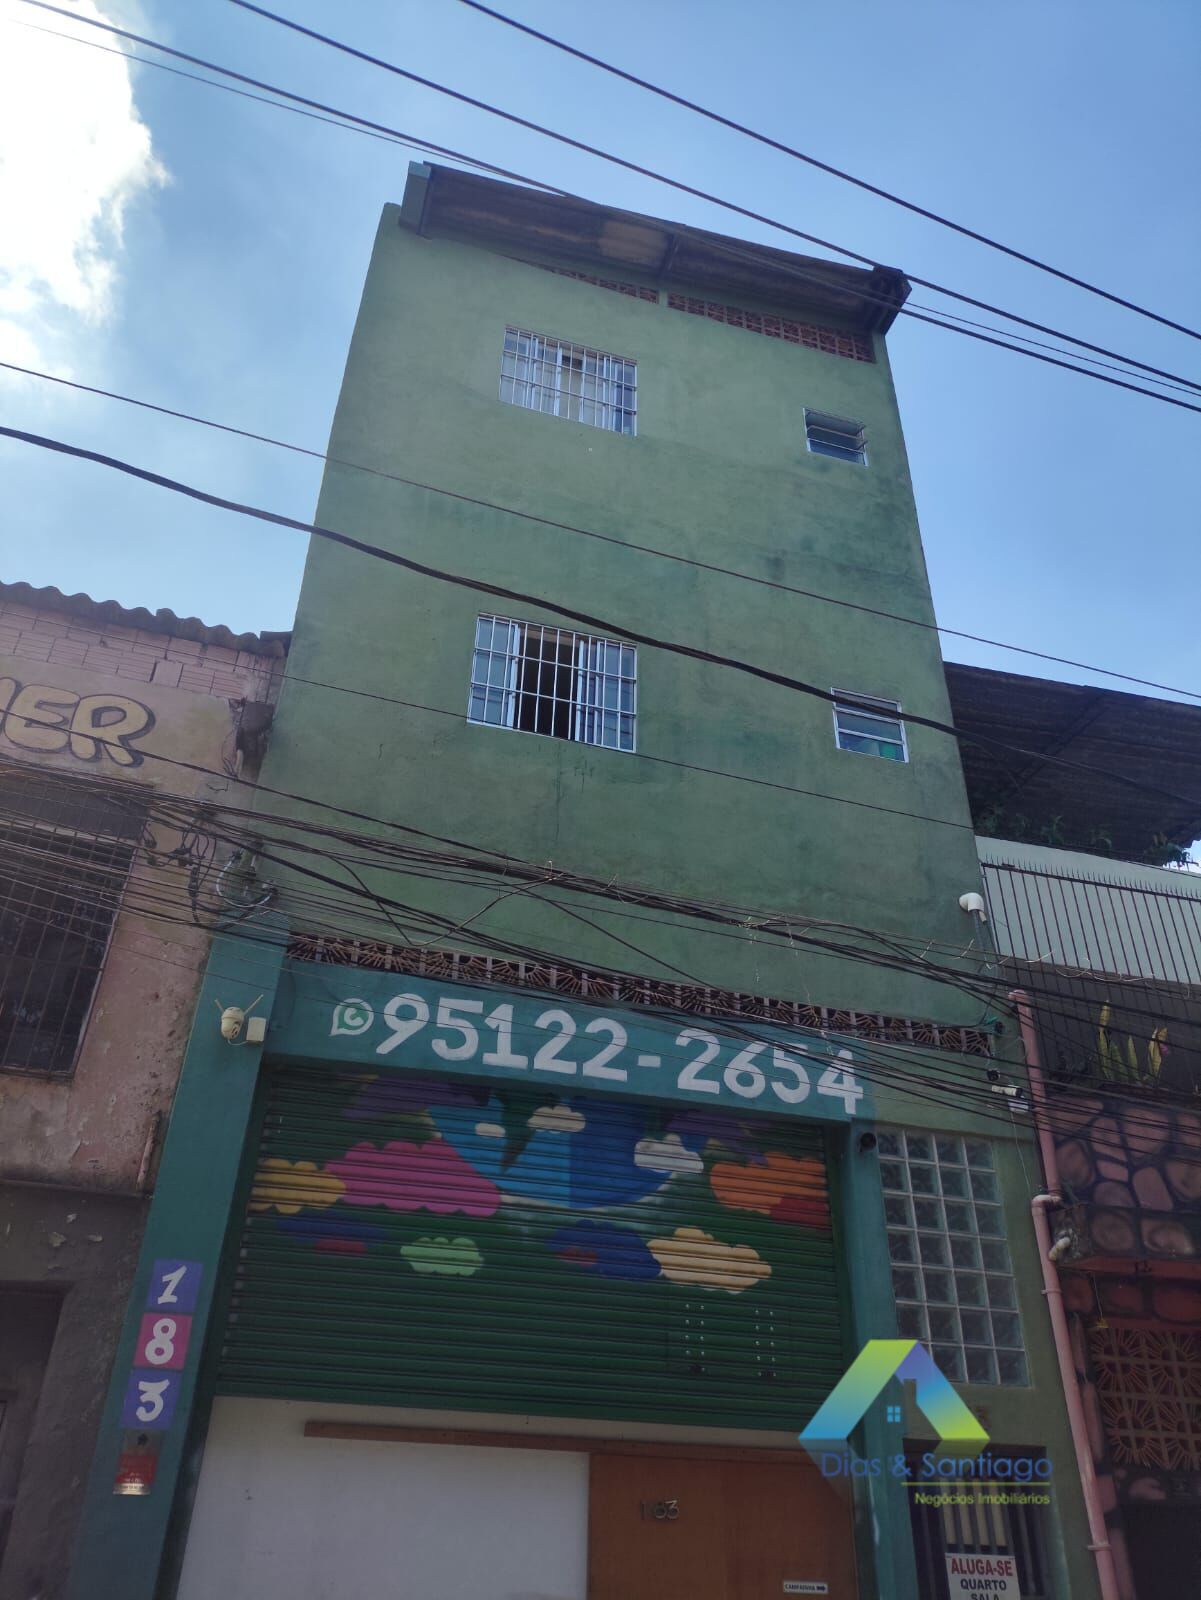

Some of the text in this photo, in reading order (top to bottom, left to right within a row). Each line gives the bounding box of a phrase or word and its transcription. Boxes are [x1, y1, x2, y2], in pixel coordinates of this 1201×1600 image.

[0, 677, 156, 767] ER
[951, 1558, 1013, 1576] ALUGA-SE
[960, 1578, 1007, 1591] QUARTO
